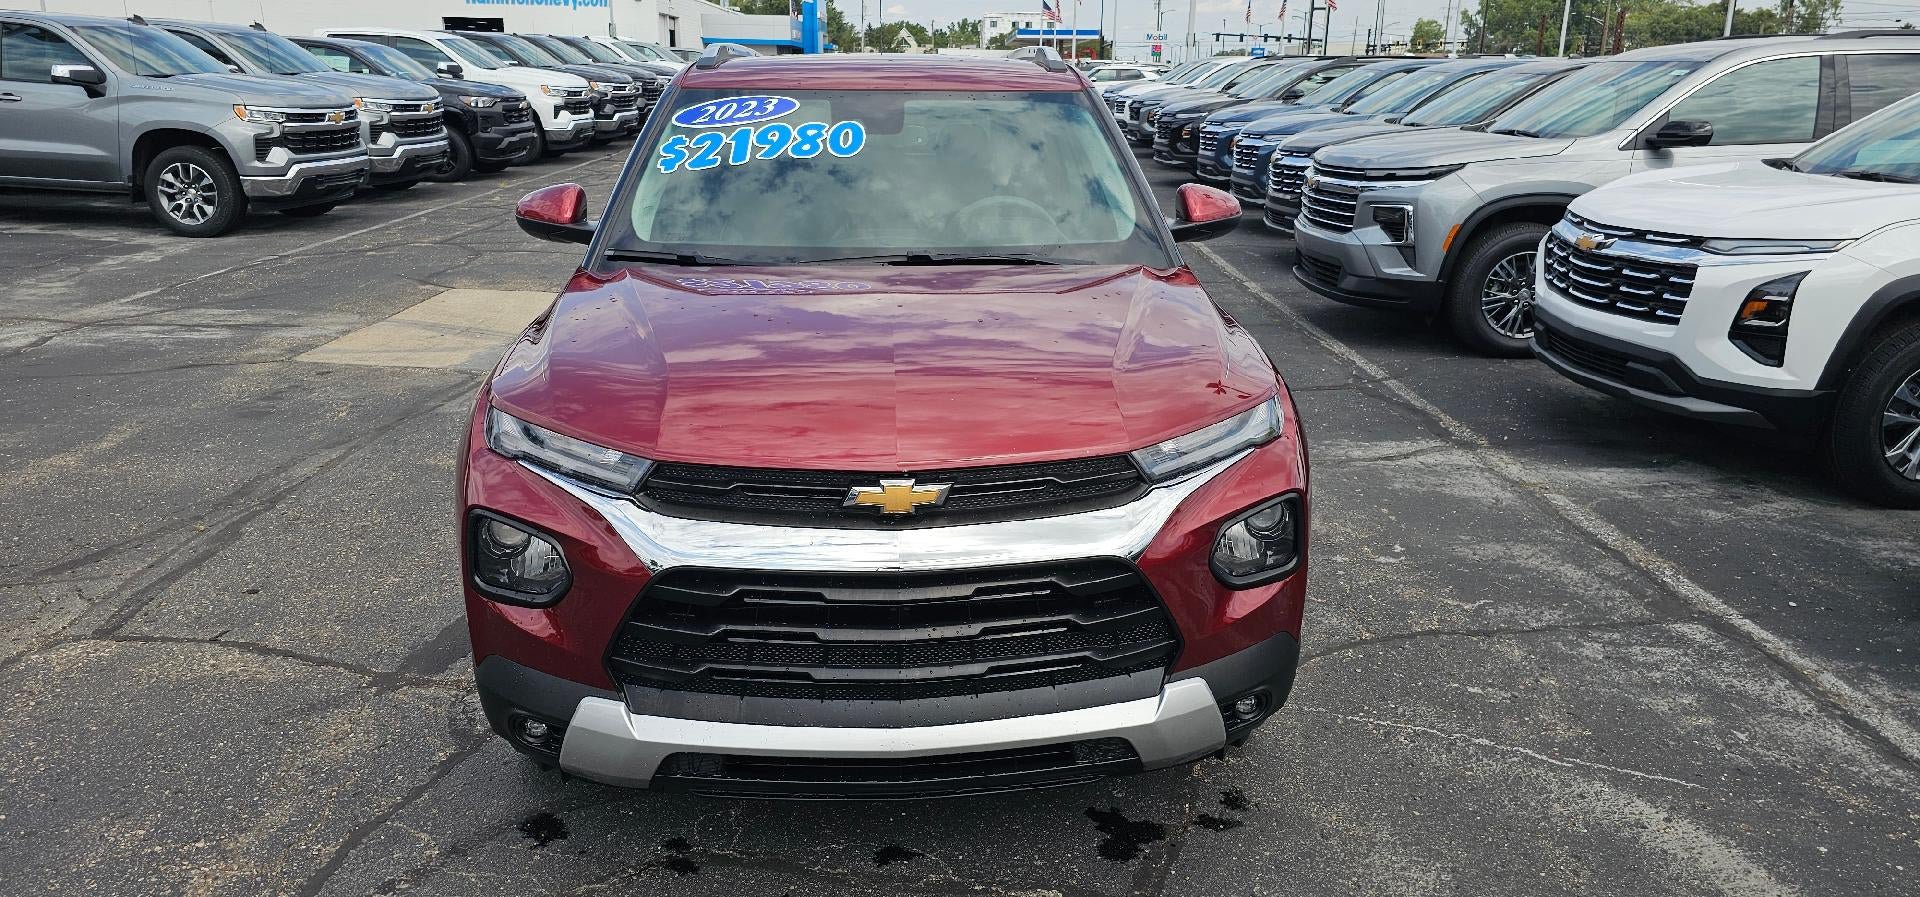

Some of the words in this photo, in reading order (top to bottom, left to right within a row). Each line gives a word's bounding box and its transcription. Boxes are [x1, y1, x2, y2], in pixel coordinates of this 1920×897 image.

[1145, 33, 1168, 41] Mobil
[693, 98, 779, 123] 2023
[657, 120, 866, 174] $21980
